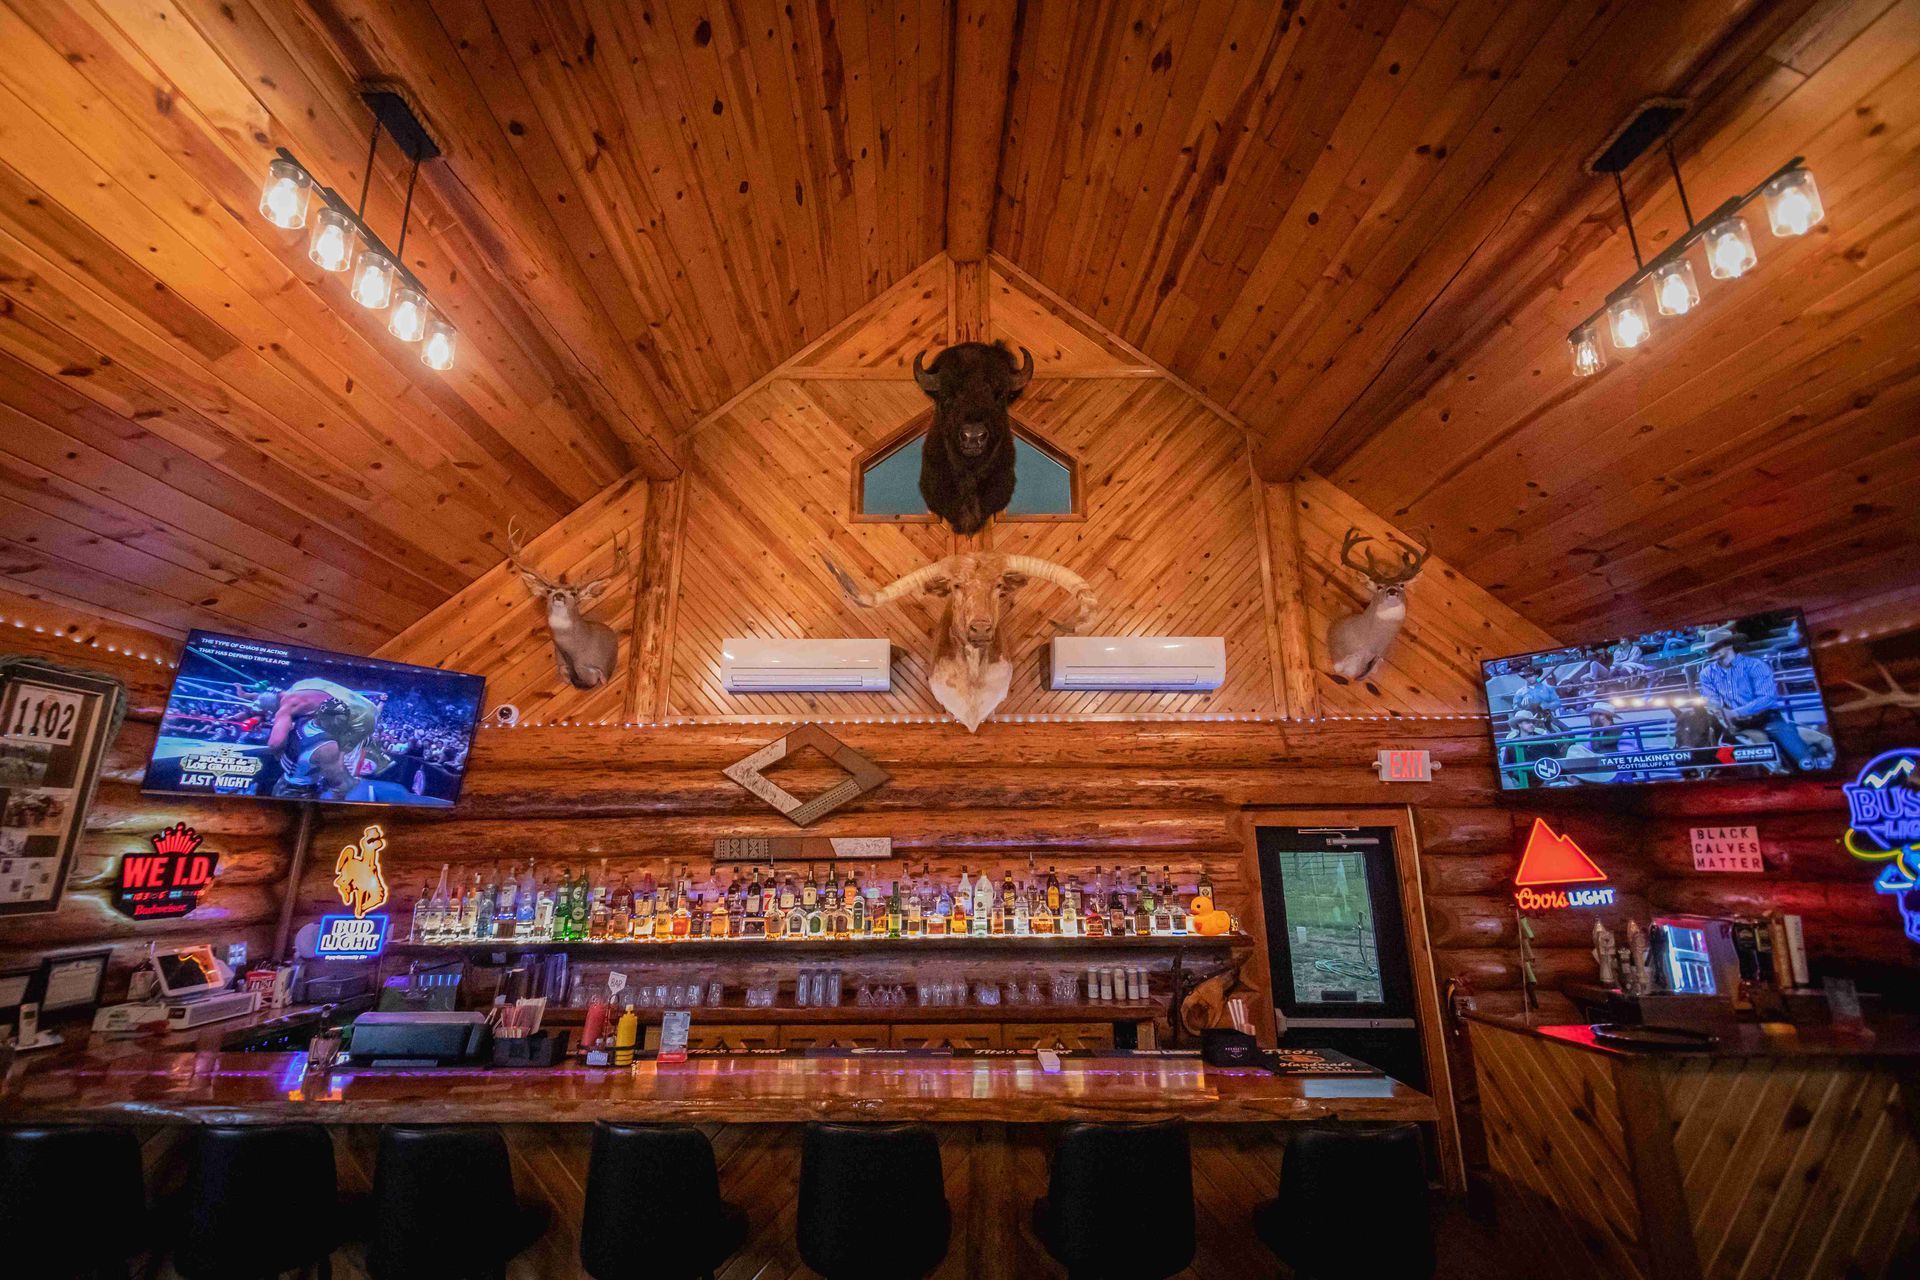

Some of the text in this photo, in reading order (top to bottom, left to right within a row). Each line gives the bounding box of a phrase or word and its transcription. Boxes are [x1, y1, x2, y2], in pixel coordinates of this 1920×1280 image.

[215, 640, 229, 648] TYPE
[239, 644, 259, 652] CHAOS
[199, 647, 214, 655] THAT
[228, 652, 253, 660] DEFINED
[253, 655, 272, 663] TRIPLE
[13, 697, 75, 740] 1102
[199, 754, 235, 765] NOCHE
[1601, 751, 1691, 766] TATE TALKINGTON
[1734, 748, 1773, 757] CINCH
[186, 760, 256, 774] LOS GRANDES
[1390, 751, 1423, 778] EXIT
[1617, 762, 1666, 770] SCOTTSBLUFF,
[180, 773, 253, 789] LAST NIGHT
[1697, 828, 1750, 840] BLACK
[1695, 843, 1758, 854] CALVES
[1697, 857, 1760, 868] MATTER
[123, 857, 212, 888] WE I.D.
[1515, 887, 1614, 910] Coors LIGHT
[134, 904, 187, 915] Budweiser
[332, 920, 375, 934] BUD
[320, 934, 380, 951] LIGHT
